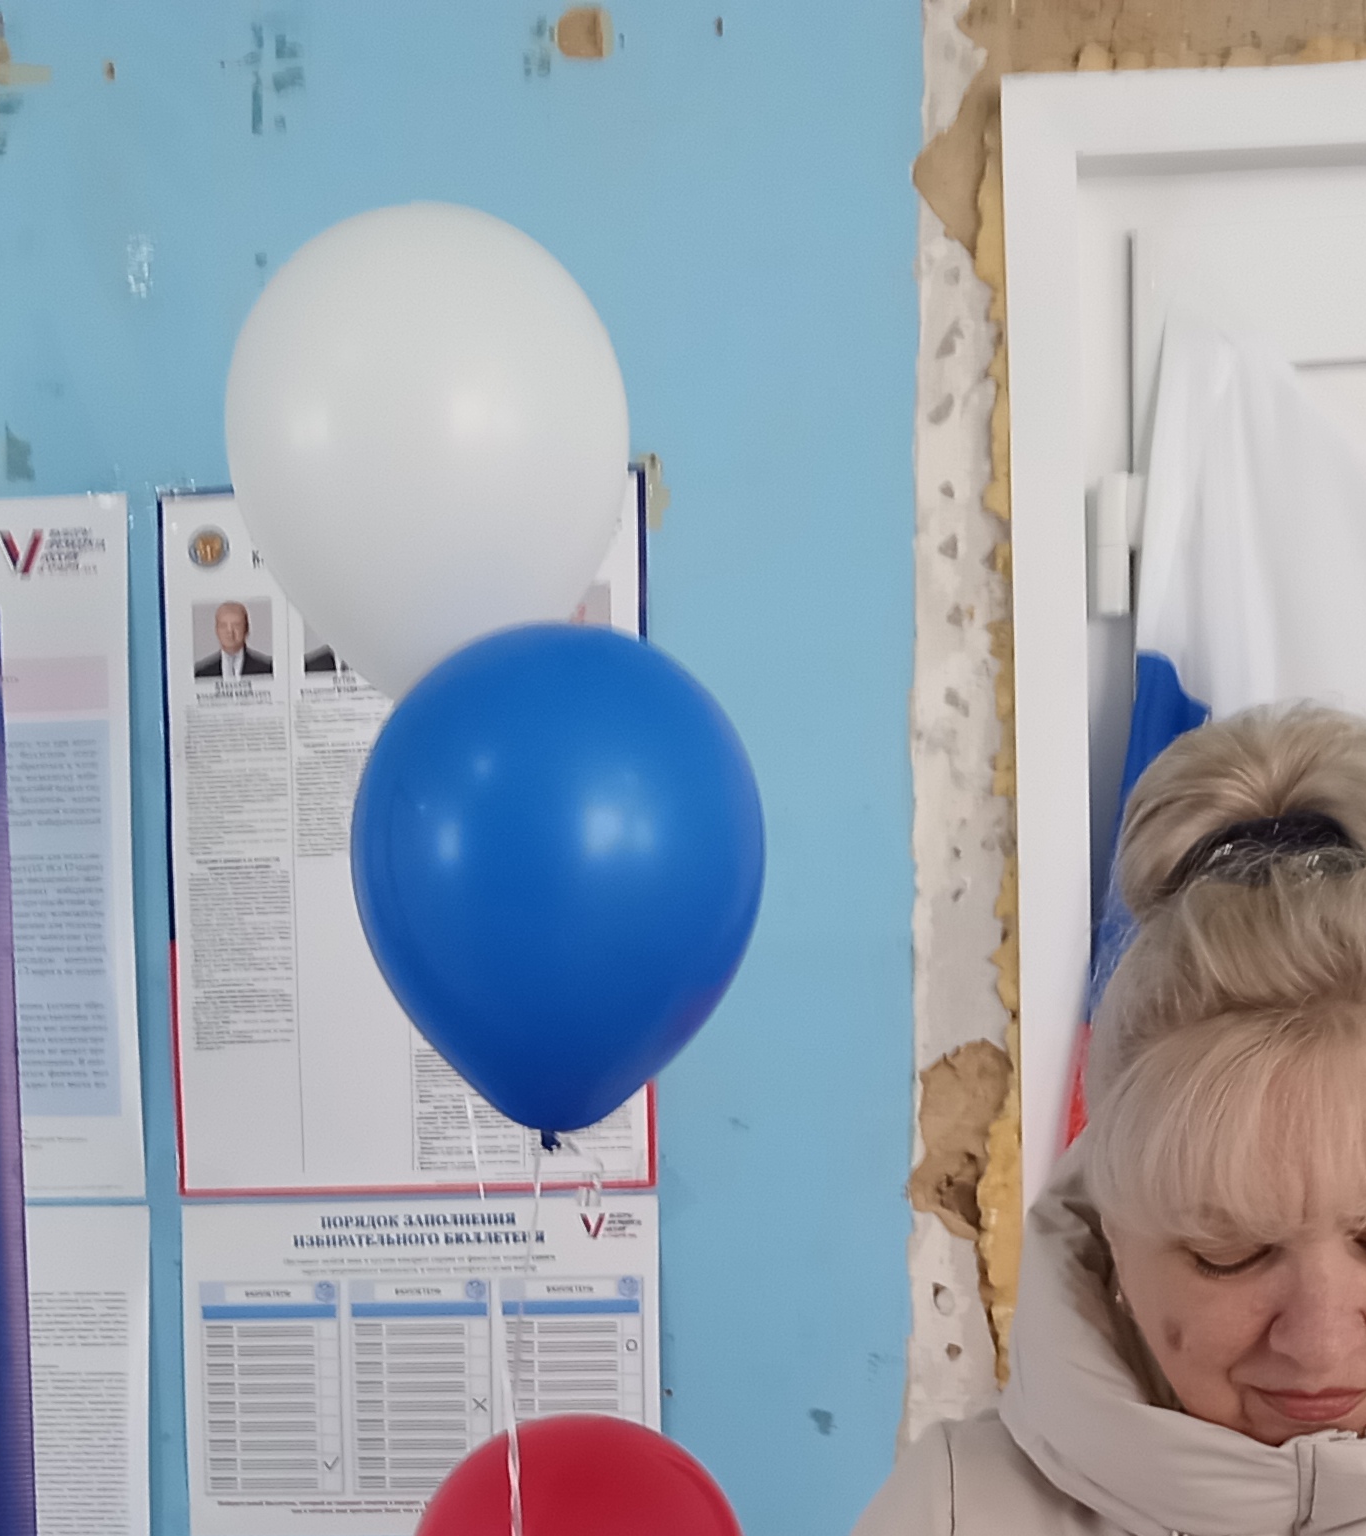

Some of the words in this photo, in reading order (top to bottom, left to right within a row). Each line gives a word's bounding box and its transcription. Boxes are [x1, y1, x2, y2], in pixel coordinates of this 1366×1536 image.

[320, 1214, 400, 1230] ПОРЯДОК
[402, 1211, 516, 1228] ЗАПОЛНЕНИЯ
[292, 1231, 441, 1249] ИЗБИРАТЕЛЬНОГО
